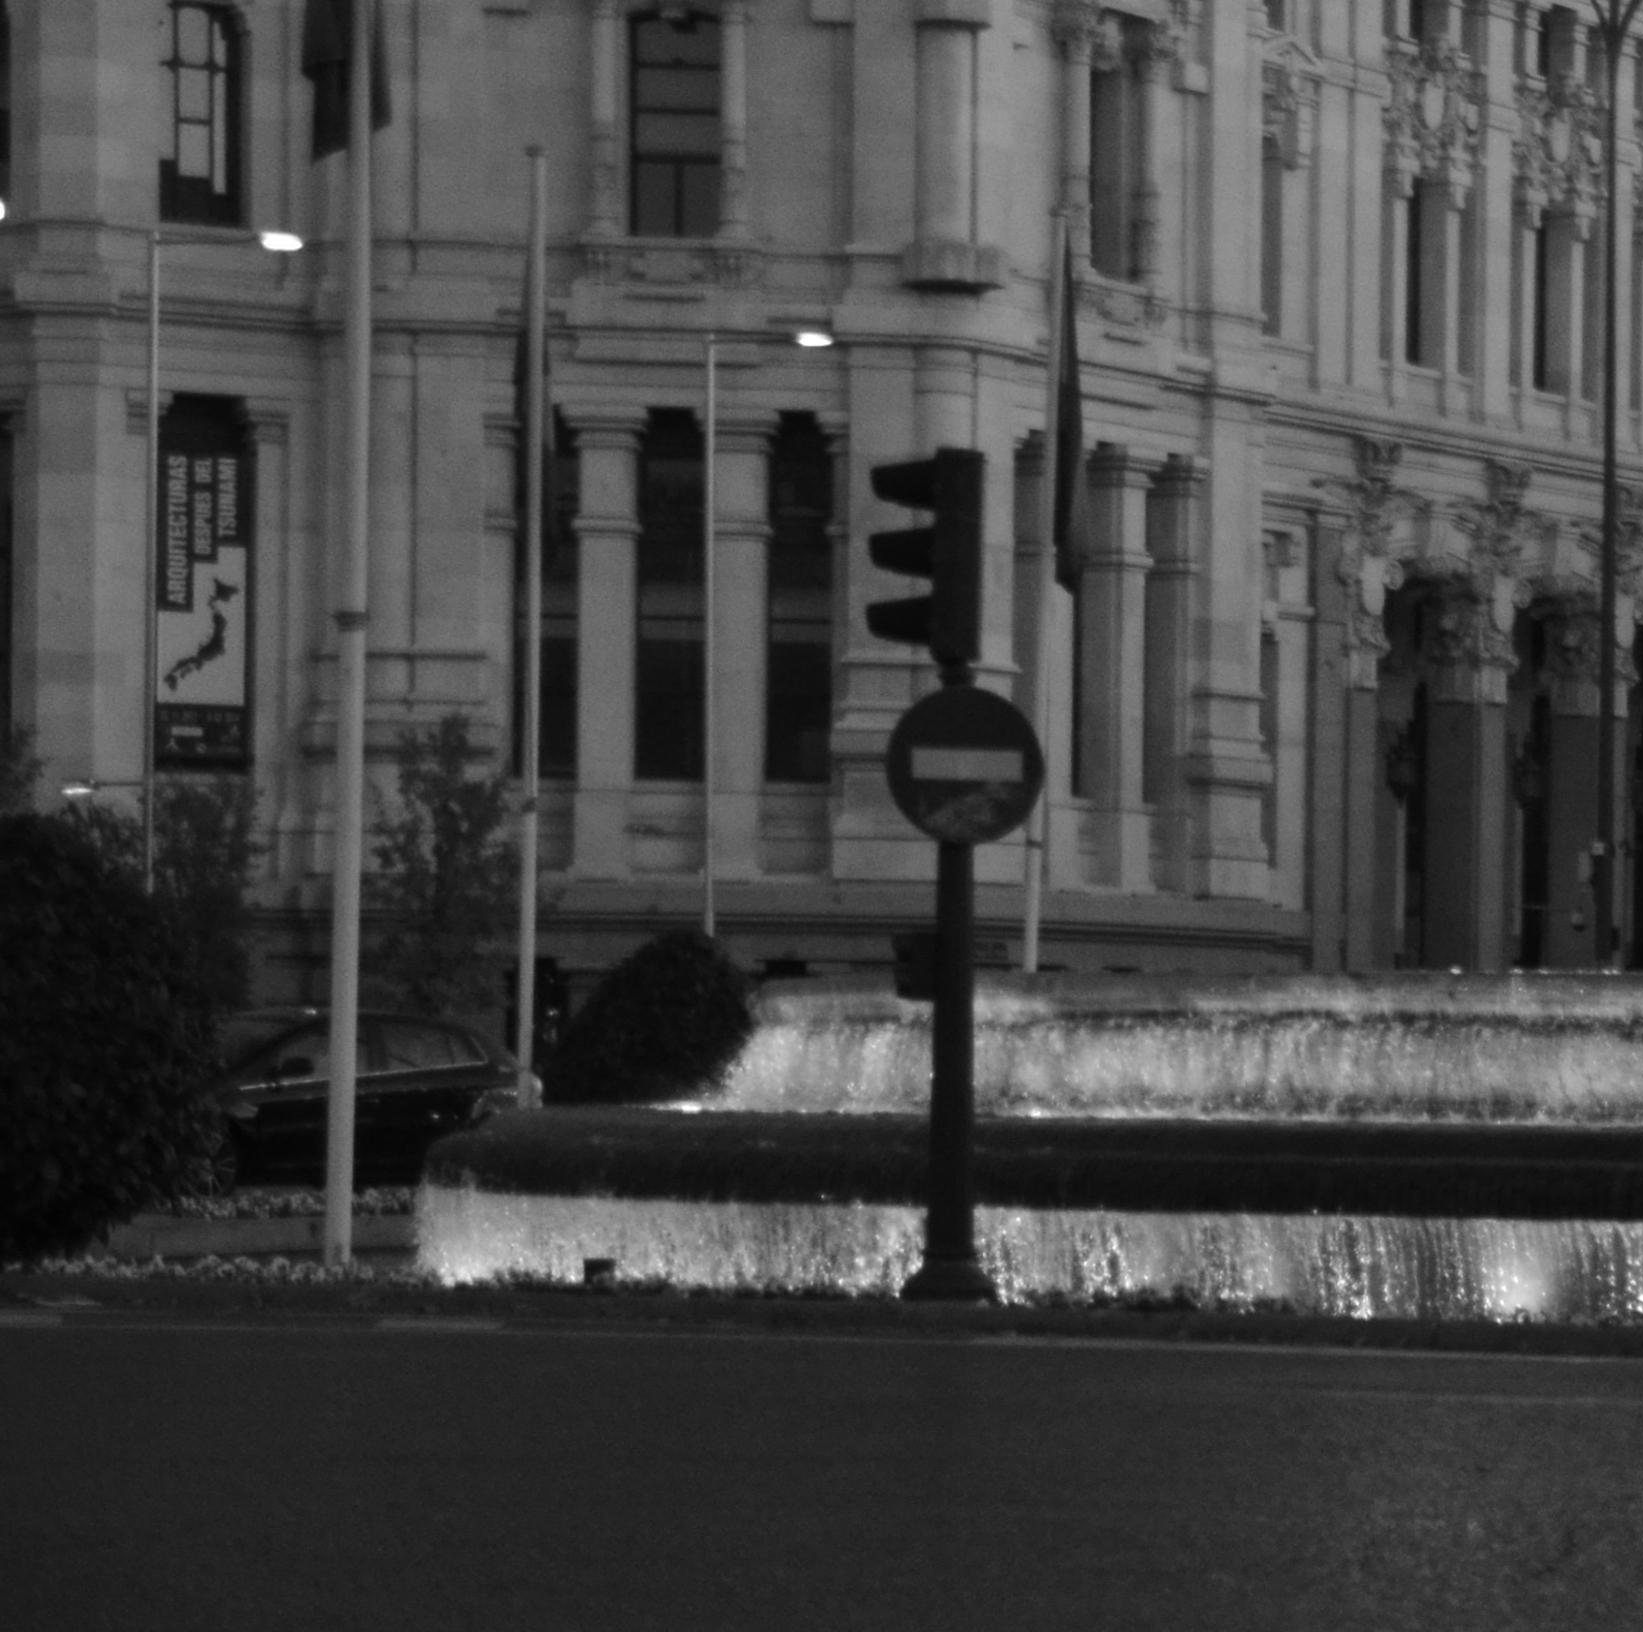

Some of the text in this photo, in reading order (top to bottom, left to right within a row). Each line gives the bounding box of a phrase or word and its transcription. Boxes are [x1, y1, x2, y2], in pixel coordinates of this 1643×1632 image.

[194, 457, 213, 484] DEL
[217, 457, 237, 537] TSUNAMI
[167, 455, 188, 605] ARQUITECTURAS
